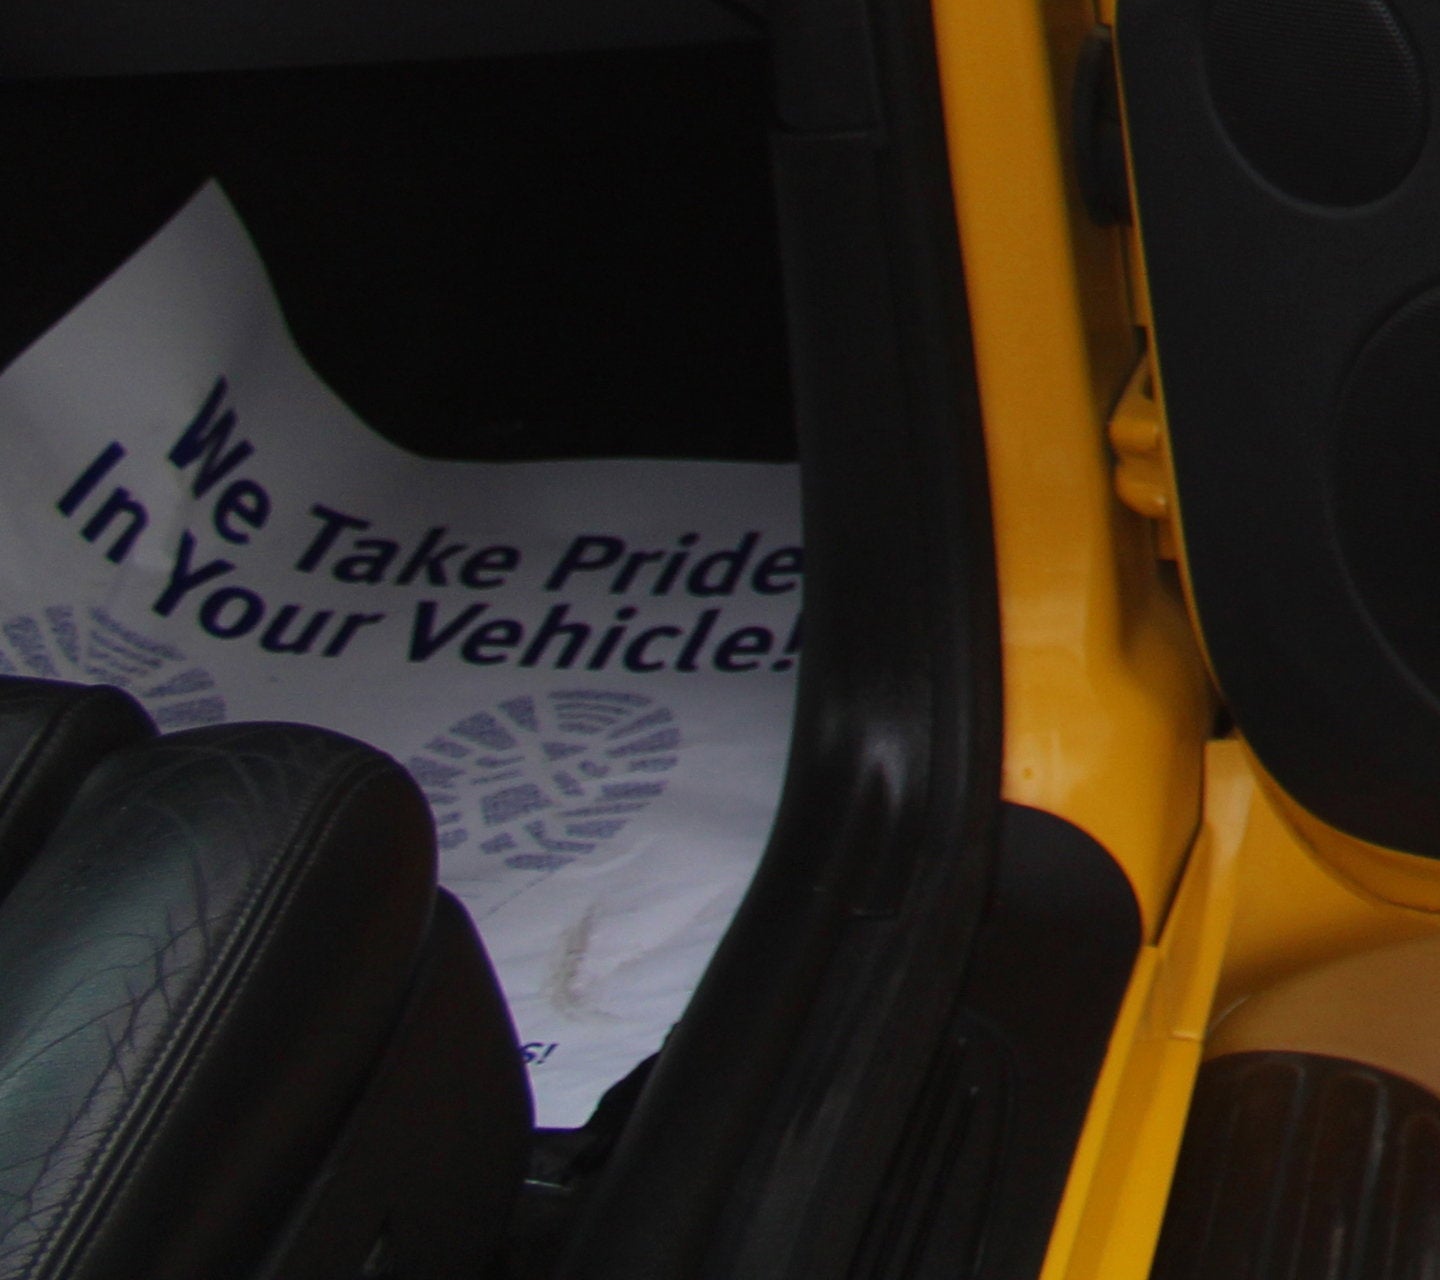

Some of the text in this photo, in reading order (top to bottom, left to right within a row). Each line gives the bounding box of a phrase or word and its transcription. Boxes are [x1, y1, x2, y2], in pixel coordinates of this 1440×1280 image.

[55, 440, 803, 674] In Your Vehicle!
[167, 374, 802, 597] We Take Pride
